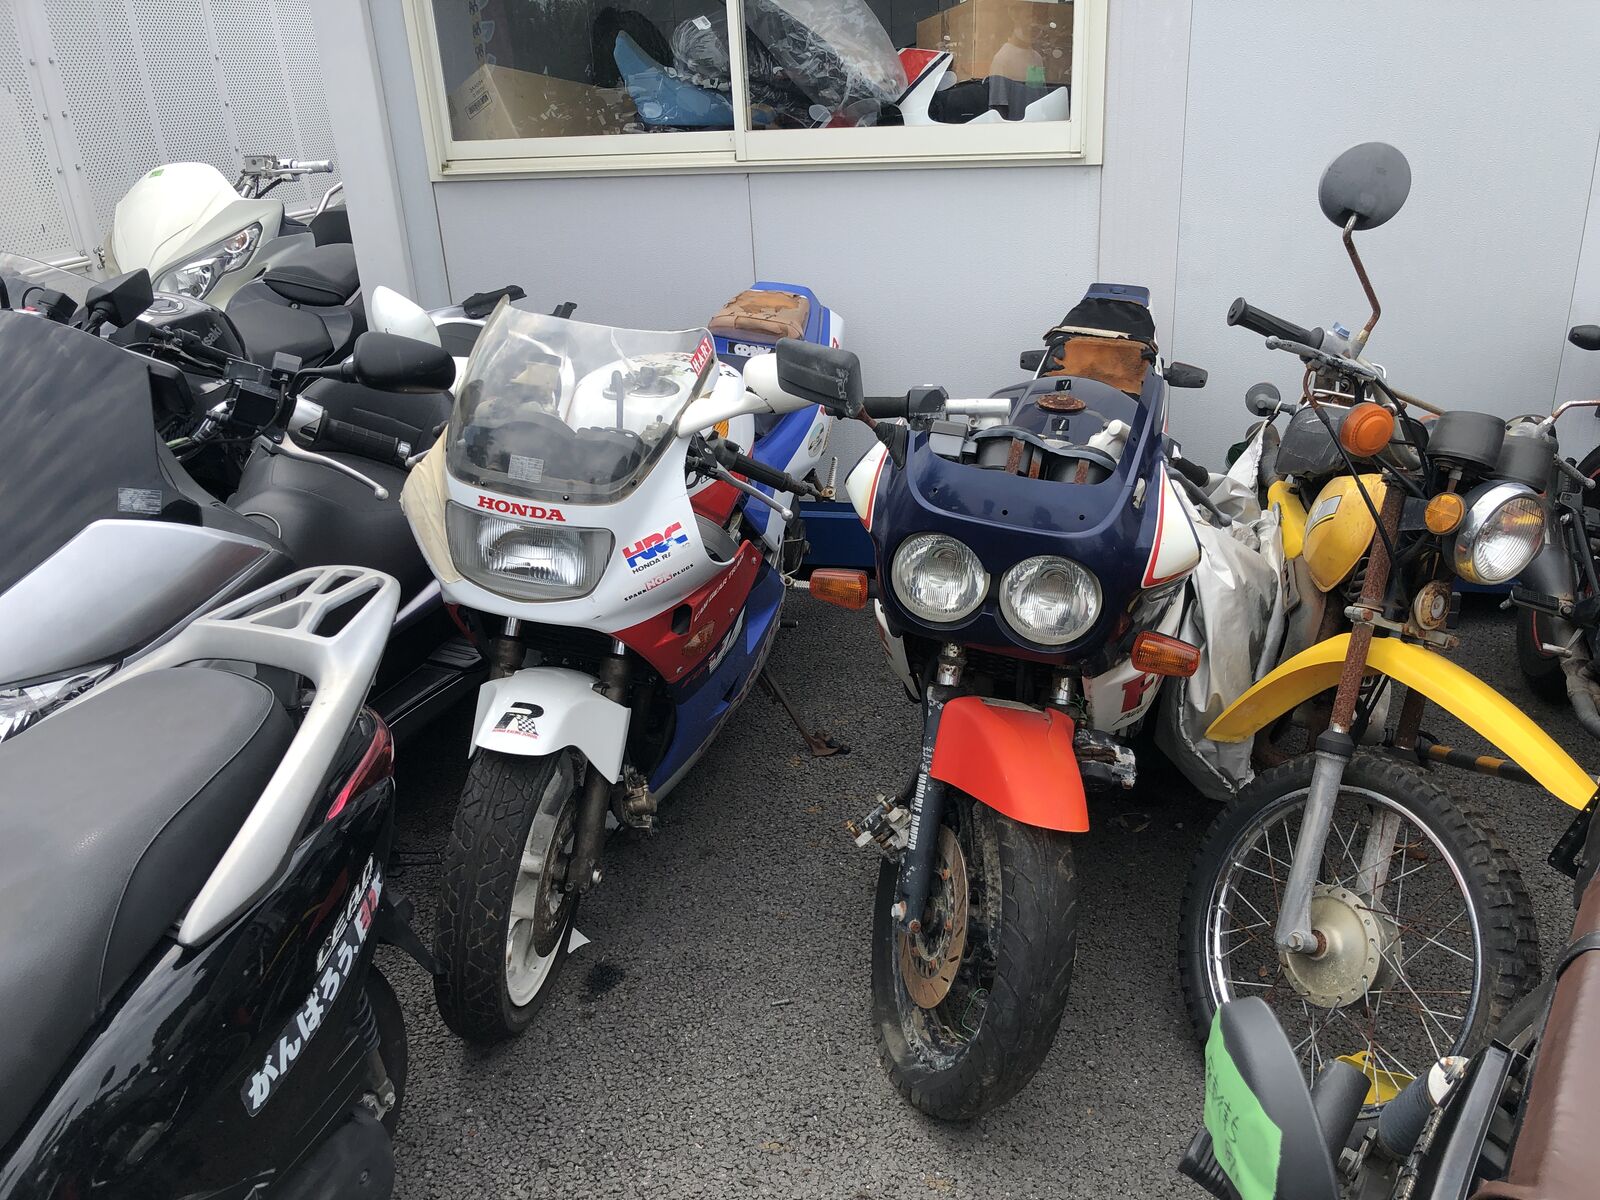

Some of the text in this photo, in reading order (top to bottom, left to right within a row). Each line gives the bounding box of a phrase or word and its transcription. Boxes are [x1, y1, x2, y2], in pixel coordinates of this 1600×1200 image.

[477, 495, 567, 522] HONDA
[622, 521, 689, 569] HRC
[632, 557, 661, 574] HONDA
[672, 562, 695, 578] PLUGS
[913, 773, 928, 813] VARIABLE
[907, 814, 921, 851] DAMPER
